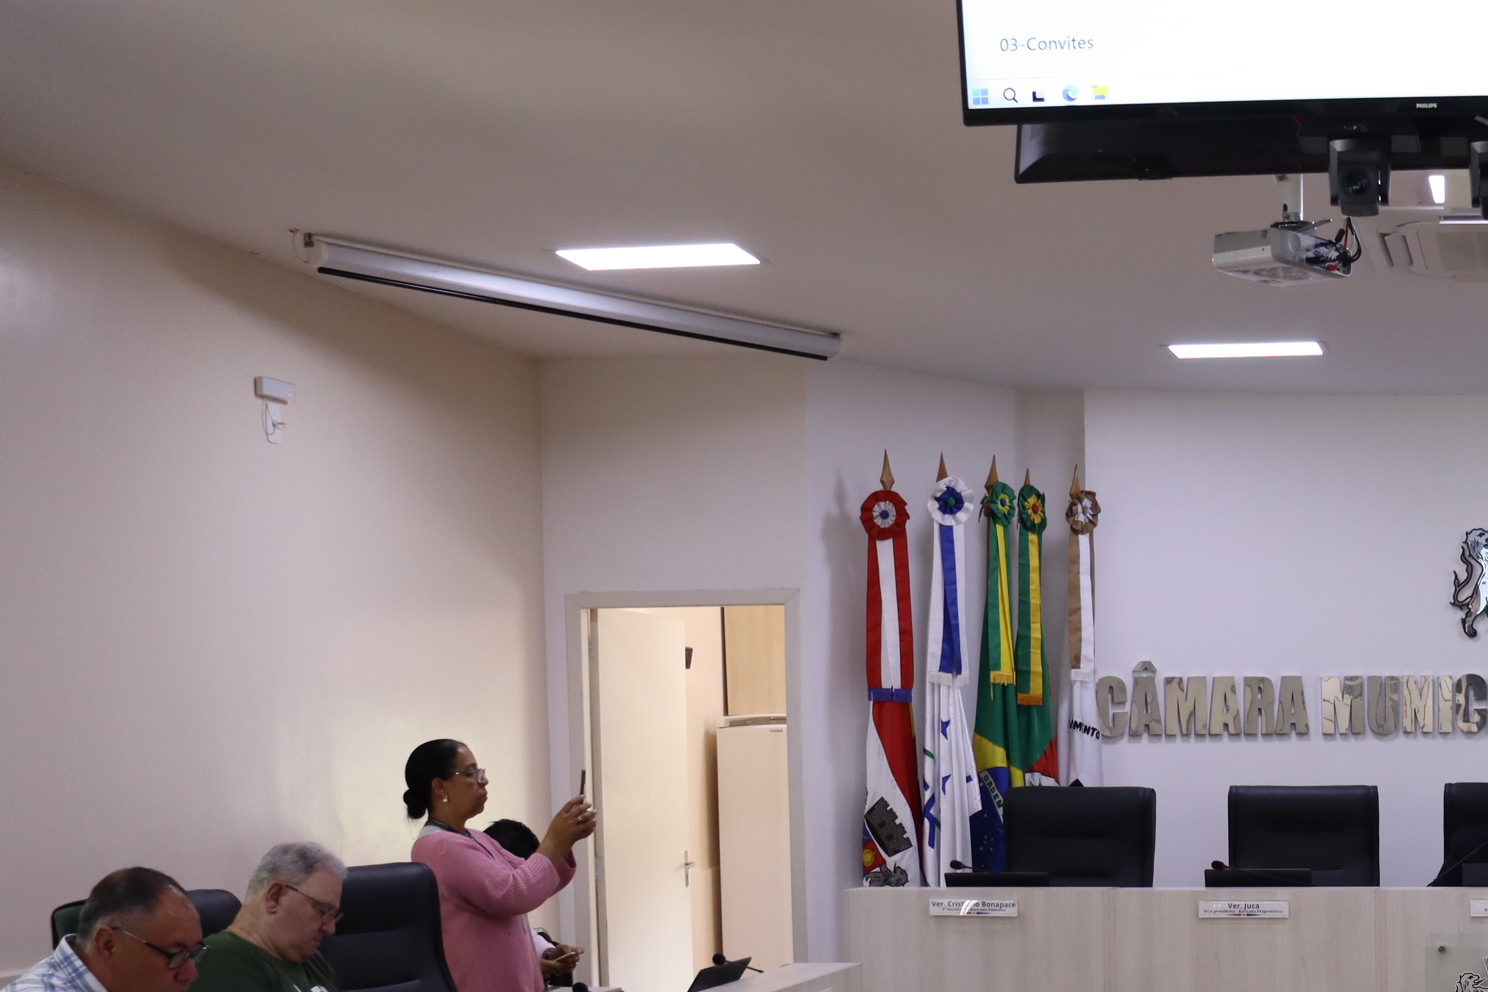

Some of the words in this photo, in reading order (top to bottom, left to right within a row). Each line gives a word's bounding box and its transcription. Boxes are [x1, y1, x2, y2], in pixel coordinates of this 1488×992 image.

[1000, 35, 1094, 52] 03-Convites
[1096, 660, 1310, 738] CÂMARA
[982, 901, 1016, 909] Bonapace
[1244, 902, 1260, 910] Juca
